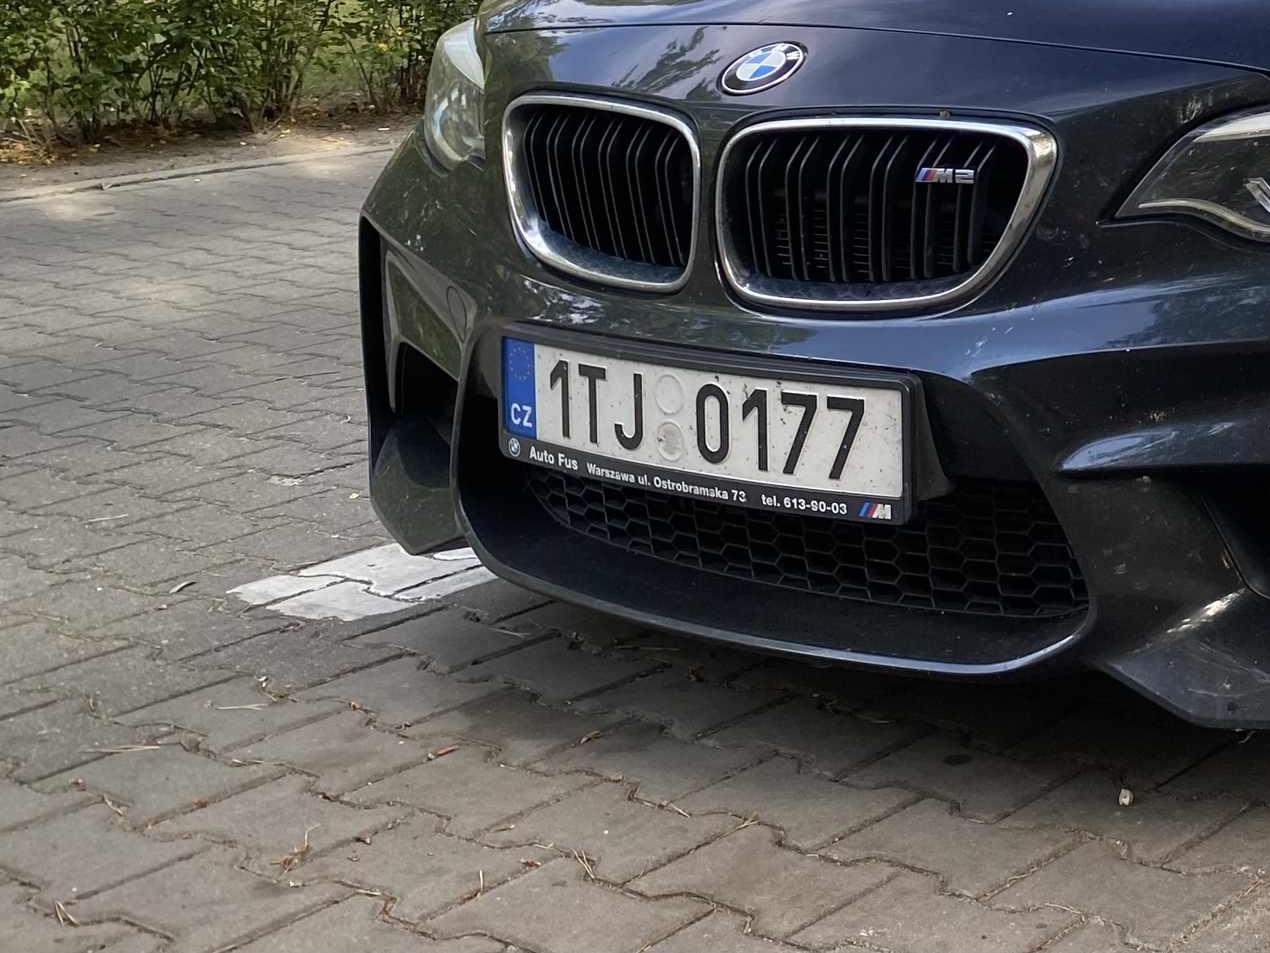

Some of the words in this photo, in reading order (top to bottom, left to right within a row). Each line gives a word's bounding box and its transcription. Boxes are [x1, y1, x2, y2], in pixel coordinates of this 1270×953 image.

[510, 402, 533, 428] CZ
[550, 360, 644, 452] 1TJ
[696, 381, 866, 481] 0177
[529, 446, 555, 465] Auto
[557, 454, 579, 471] Fus
[586, 462, 636, 484] Warszawa
[638, 474, 651, 487] ul.
[653, 476, 729, 502] Ostrobramska
[731, 489, 748, 503] 73
[761, 493, 781, 508] tel.
[783, 497, 848, 516] 613-90-03
